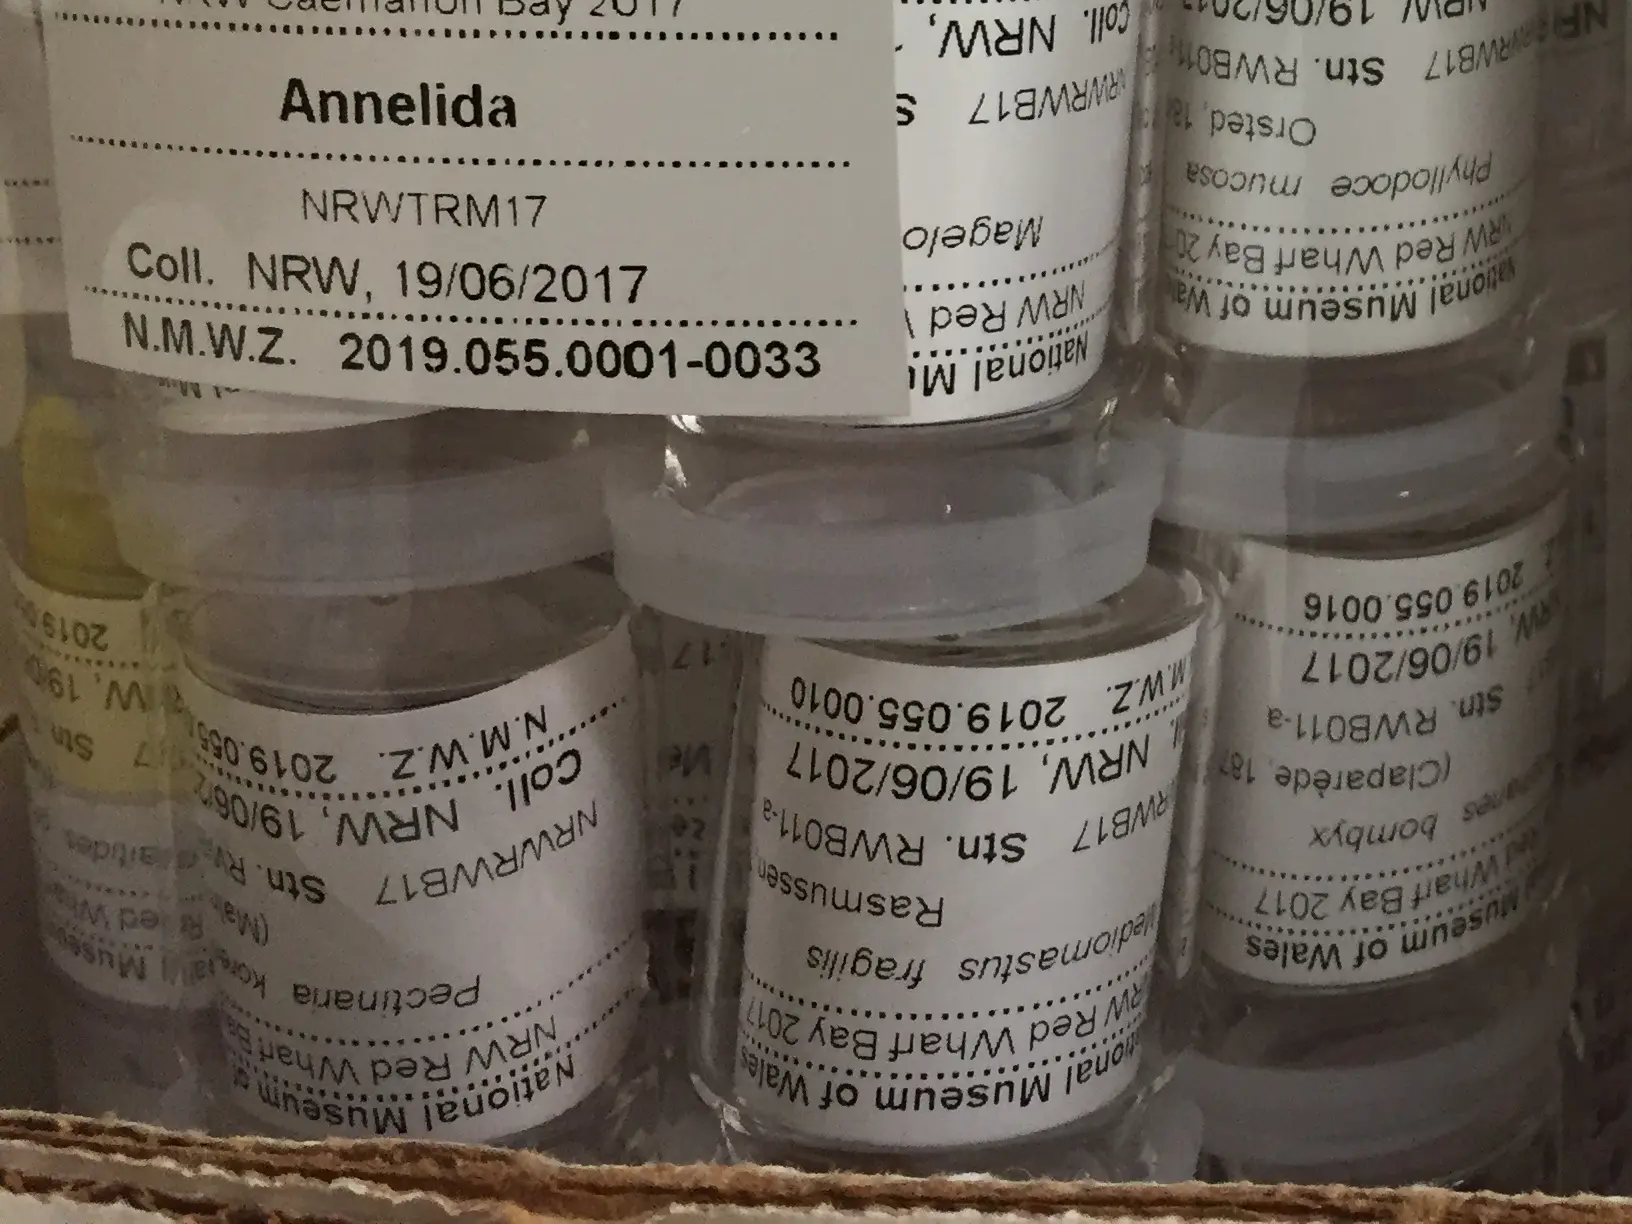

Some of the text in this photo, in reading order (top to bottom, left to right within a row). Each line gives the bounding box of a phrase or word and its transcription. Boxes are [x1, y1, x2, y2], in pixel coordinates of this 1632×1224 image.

[929, 0, 1131, 58] Coll. NRW,
[1314, 56, 1385, 86] Stn.
[280, 78, 518, 128] Annelida
[1186, 152, 1492, 199] Phyllodoce mucosa
[302, 189, 548, 229] NRWTRM17
[127, 243, 648, 305] Coll. NRW, 19/06/2017
[1208, 234, 1456, 276] Red Wharf Bay
[930, 280, 1085, 336] NRW Red
[1219, 290, 1418, 323] Museum of
[124, 312, 821, 380] N.M.W.Z. 2019.055.0001-0033
[973, 331, 1089, 391] National
[1302, 561, 1524, 623] 2019.055.0016
[1301, 628, 1496, 684] 19/06/2017
[791, 677, 1067, 734] 2019.055.0010
[1266, 706, 1438, 740] RWB011-a
[379, 705, 549, 780] N.M.W.Z.
[785, 734, 1150, 802] NRW, 19/06/2017
[322, 749, 581, 845] Coll. NRW,
[256, 802, 599, 906] NRWRWB17 Stn.
[946, 833, 1028, 865] Stn.
[1308, 812, 1439, 851] bombyx
[1255, 883, 1403, 921] Bay 2017
[806, 945, 925, 989] fragilis
[1245, 933, 1388, 971] of Wales
[292, 976, 481, 1017] Pectinaria
[370, 1017, 557, 1085] NRW Red
[746, 998, 1097, 1062] Red Wharf Bay 2017
[258, 1055, 574, 1135] National Museum
[740, 1047, 1050, 1113] Museum of Wales
